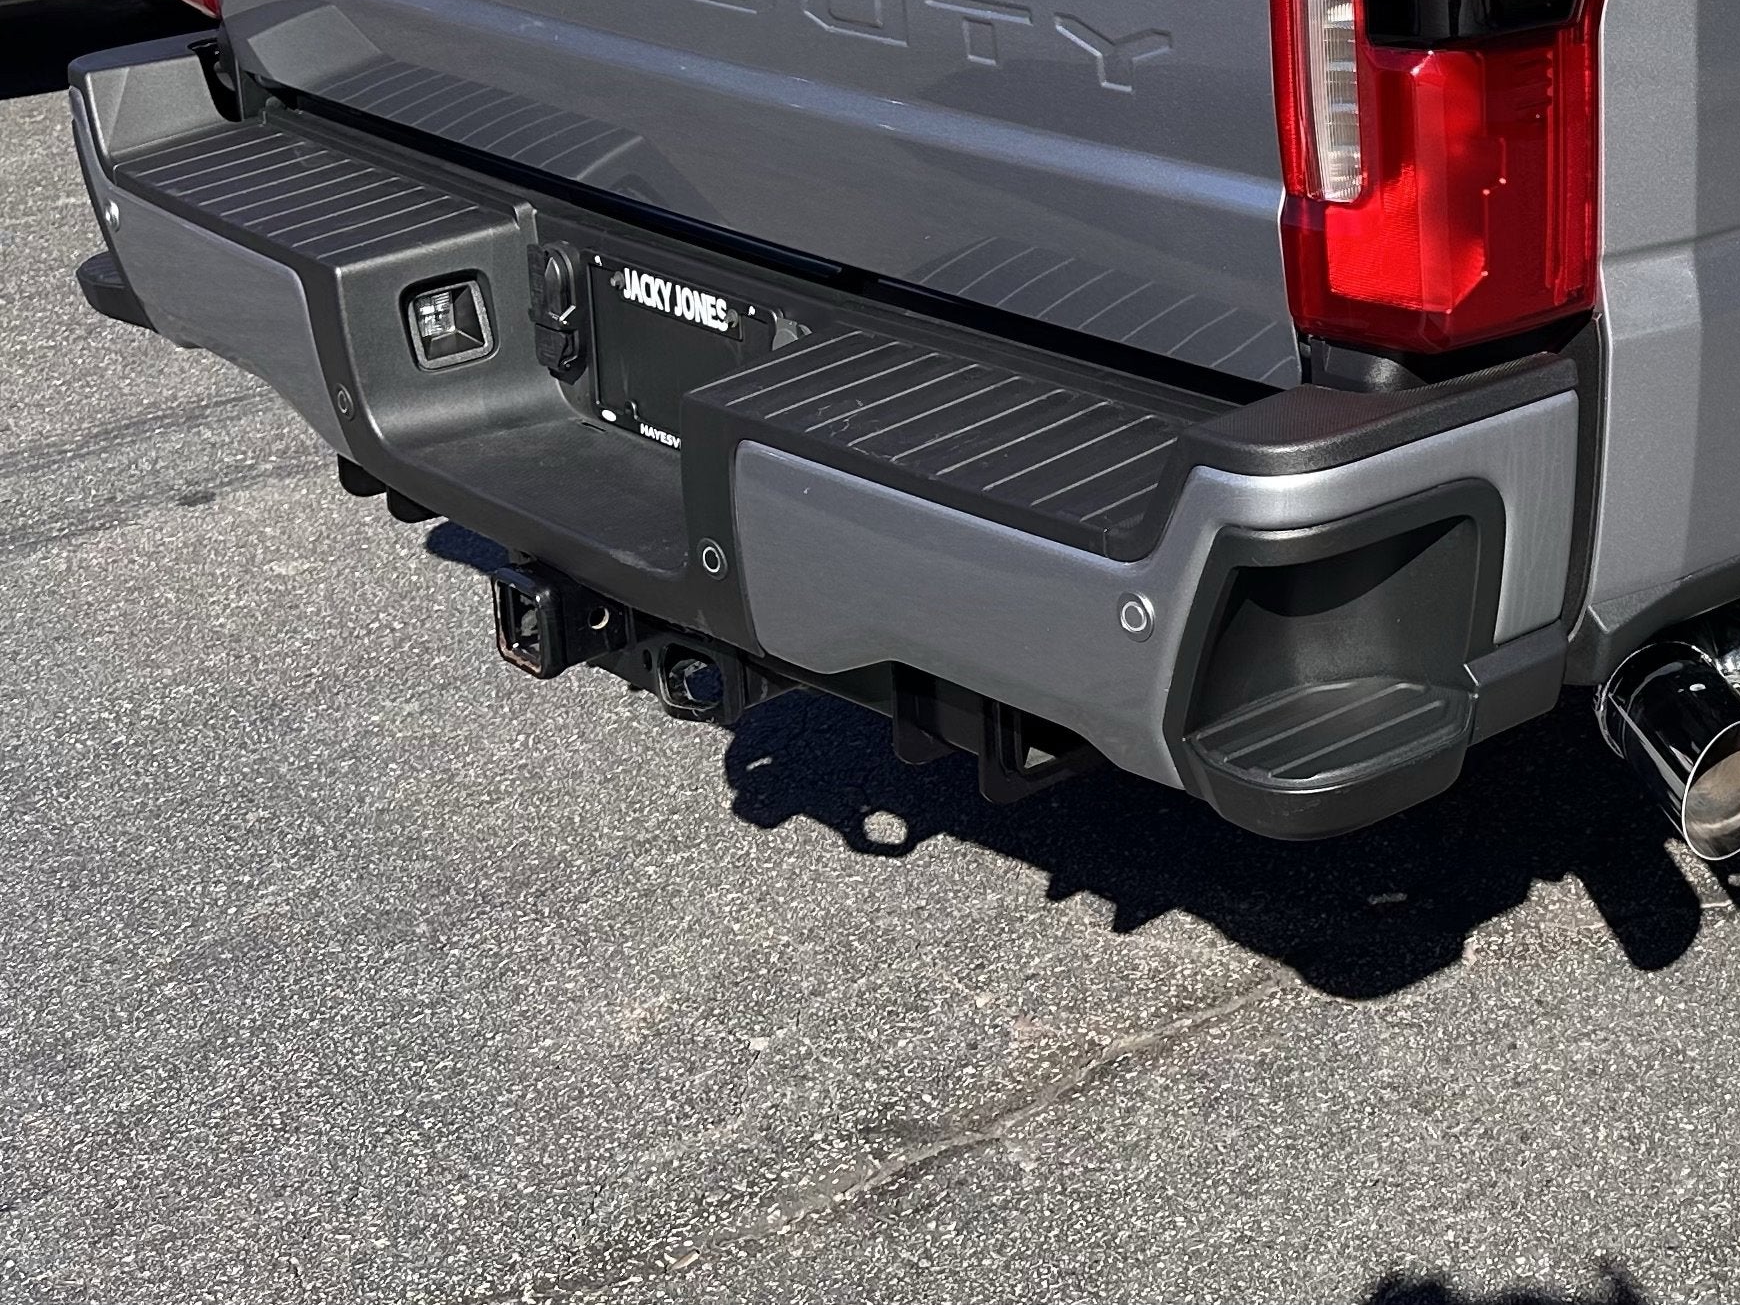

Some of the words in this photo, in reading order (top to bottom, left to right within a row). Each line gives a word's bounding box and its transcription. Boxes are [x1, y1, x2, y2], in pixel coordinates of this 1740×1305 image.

[623, 267, 673, 313] JACKY
[674, 284, 729, 332] JONES
[640, 422, 682, 450] HAYESV
